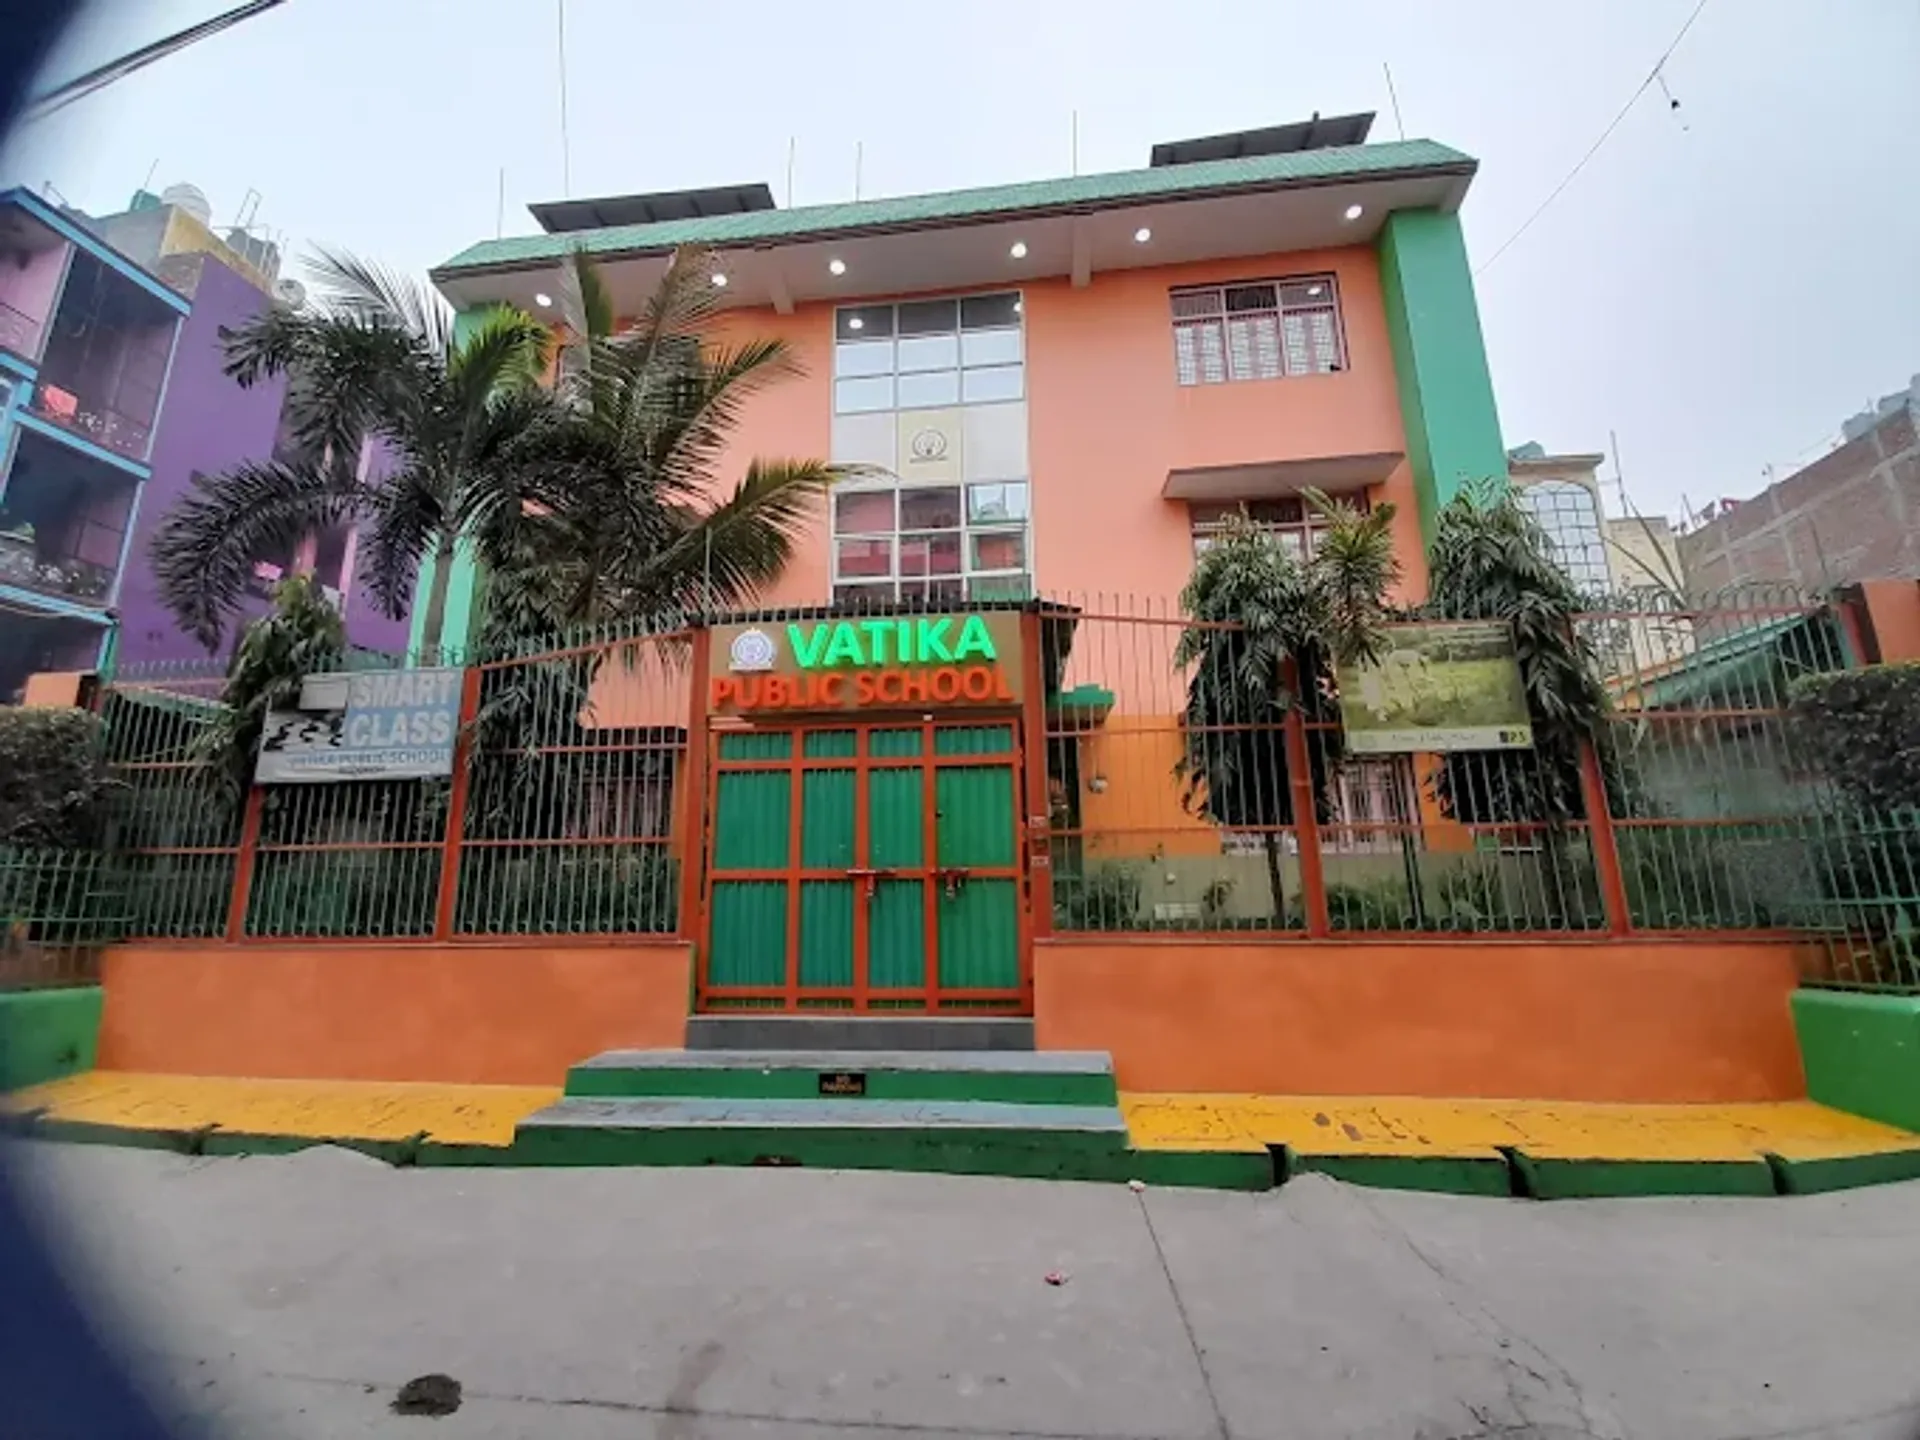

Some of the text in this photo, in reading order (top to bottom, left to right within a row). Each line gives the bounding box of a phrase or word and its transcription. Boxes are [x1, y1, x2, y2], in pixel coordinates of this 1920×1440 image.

[786, 614, 997, 668] VATIKA
[352, 673, 456, 708] SMART
[711, 664, 1014, 709] PUBLIC SCHOOL
[351, 711, 450, 747] CLASS
[390, 750, 448, 764] SCHOOL
